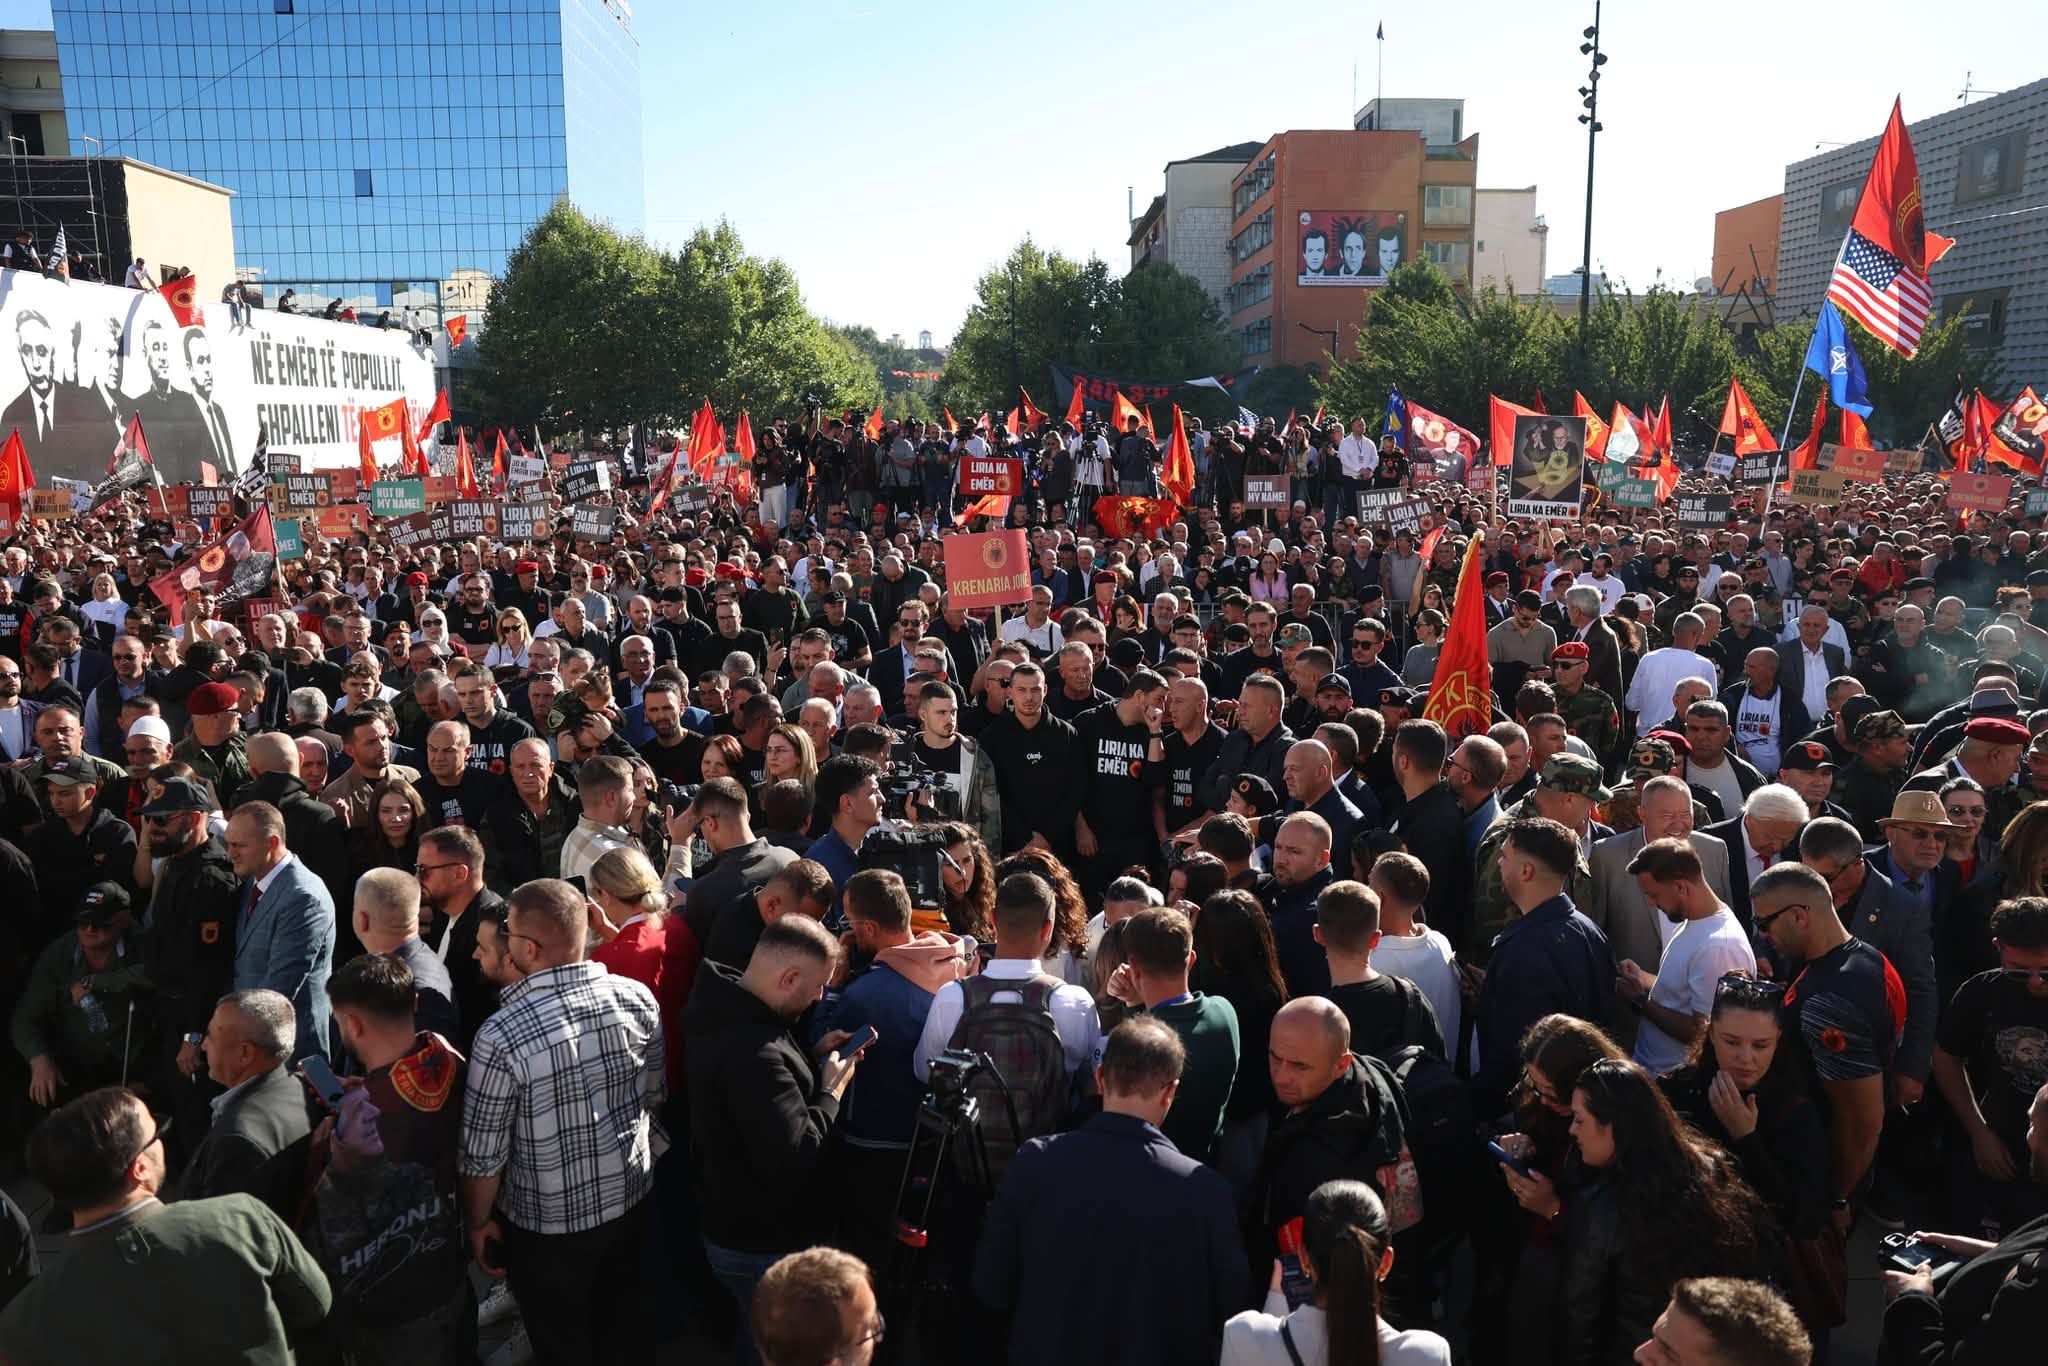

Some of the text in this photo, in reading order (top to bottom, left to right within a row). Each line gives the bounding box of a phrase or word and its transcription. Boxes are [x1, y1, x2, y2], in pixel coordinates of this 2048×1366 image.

[251, 331, 274, 385] NË
[276, 336, 319, 387] EMËR
[320, 340, 337, 388] TË
[970, 462, 1008, 475] LIRIA KA
[1744, 459, 1756, 469] JO
[1757, 455, 1768, 468] NË
[1744, 467, 1770, 479] EMRIN
[288, 477, 314, 490] LIRIA
[314, 477, 328, 490] KA
[970, 476, 995, 491] EMËR
[190, 490, 230, 502] LIRIA KA
[290, 490, 316, 505] EMËR
[1361, 492, 1403, 507] LIRIA KA
[191, 502, 217, 515] EMËR
[452, 502, 496, 517] LIRIA KA
[1387, 501, 1431, 522] LIRIA KA
[1510, 503, 1568, 516] LIRIA KA EMËR
[1680, 497, 1706, 511] JO NË
[502, 506, 546, 521] LIRIA KA
[1362, 506, 1384, 523] EMË
[1679, 510, 1727, 522] EMRIN TIM!
[454, 516, 484, 534] EMËR
[503, 520, 532, 537] EMËR
[953, 571, 1029, 597] KRENARIA JONË
[1098, 738, 1145, 759] LIRIA KA
[1097, 756, 1128, 776] EMËR
